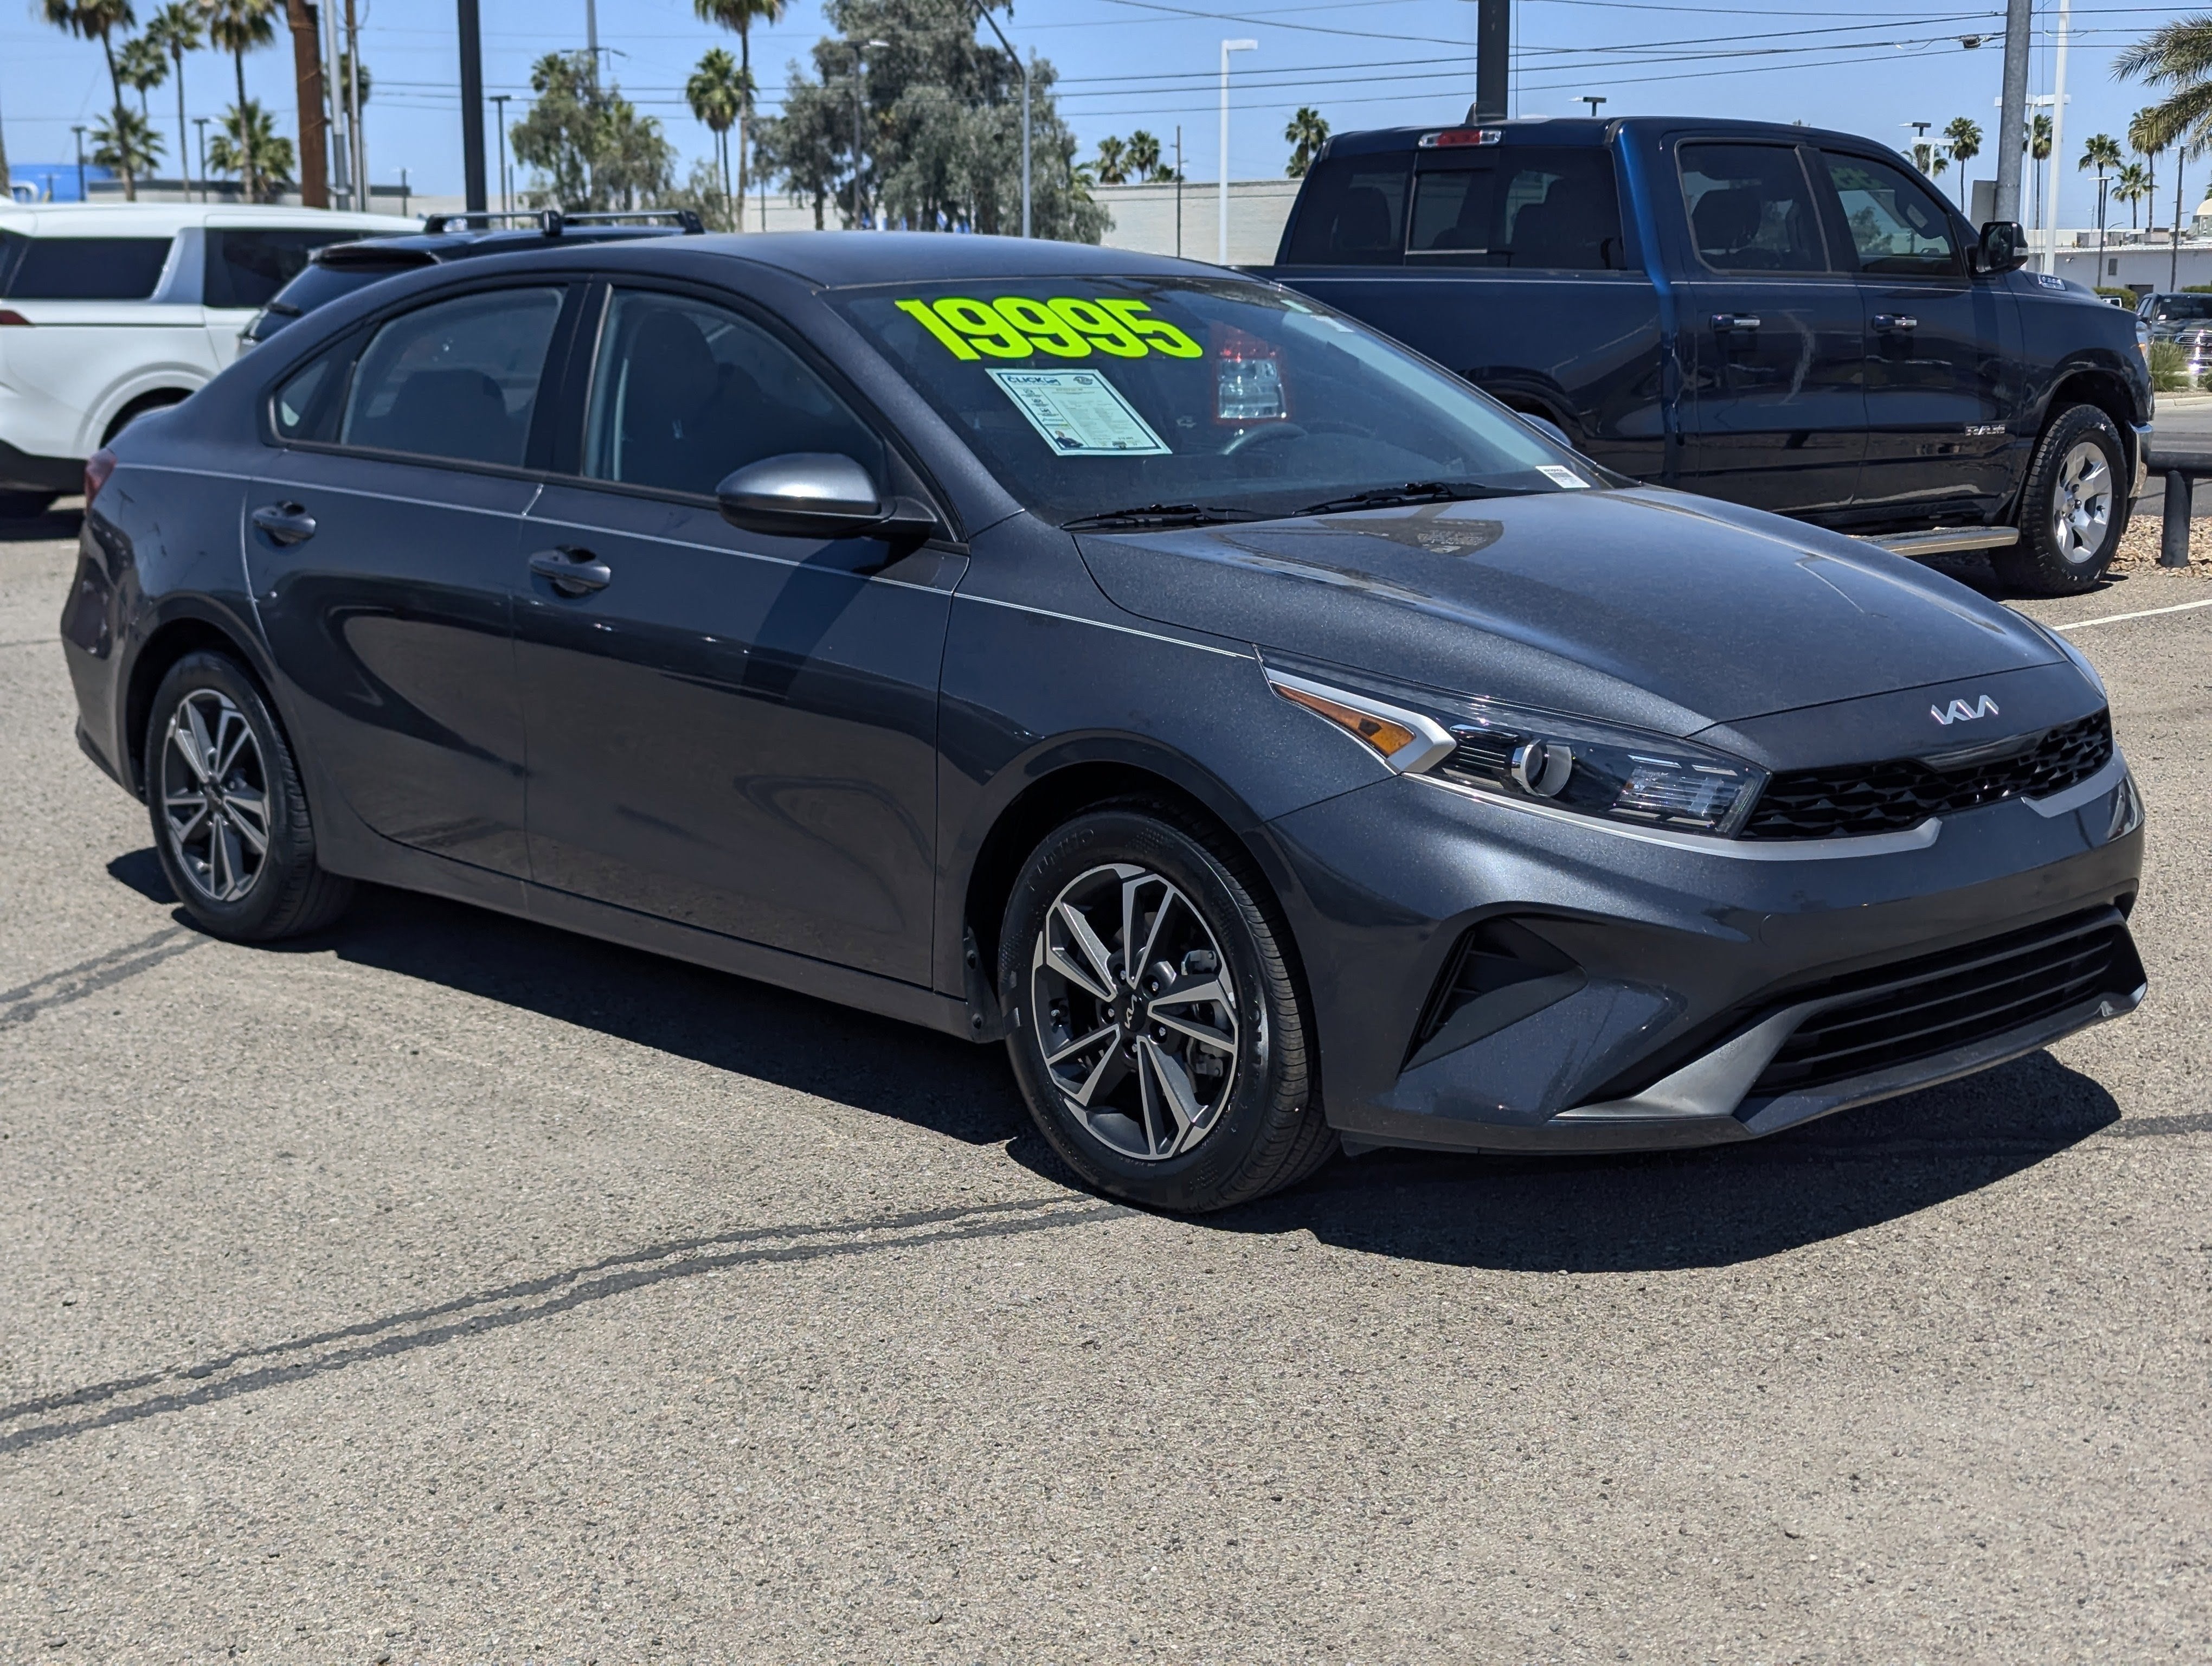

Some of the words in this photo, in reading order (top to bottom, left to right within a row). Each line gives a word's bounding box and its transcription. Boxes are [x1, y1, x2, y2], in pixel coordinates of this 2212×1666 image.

[895, 297, 1203, 360] 19995
[1965, 425, 2005, 436] RAM
[1931, 695, 1999, 725] KIA
